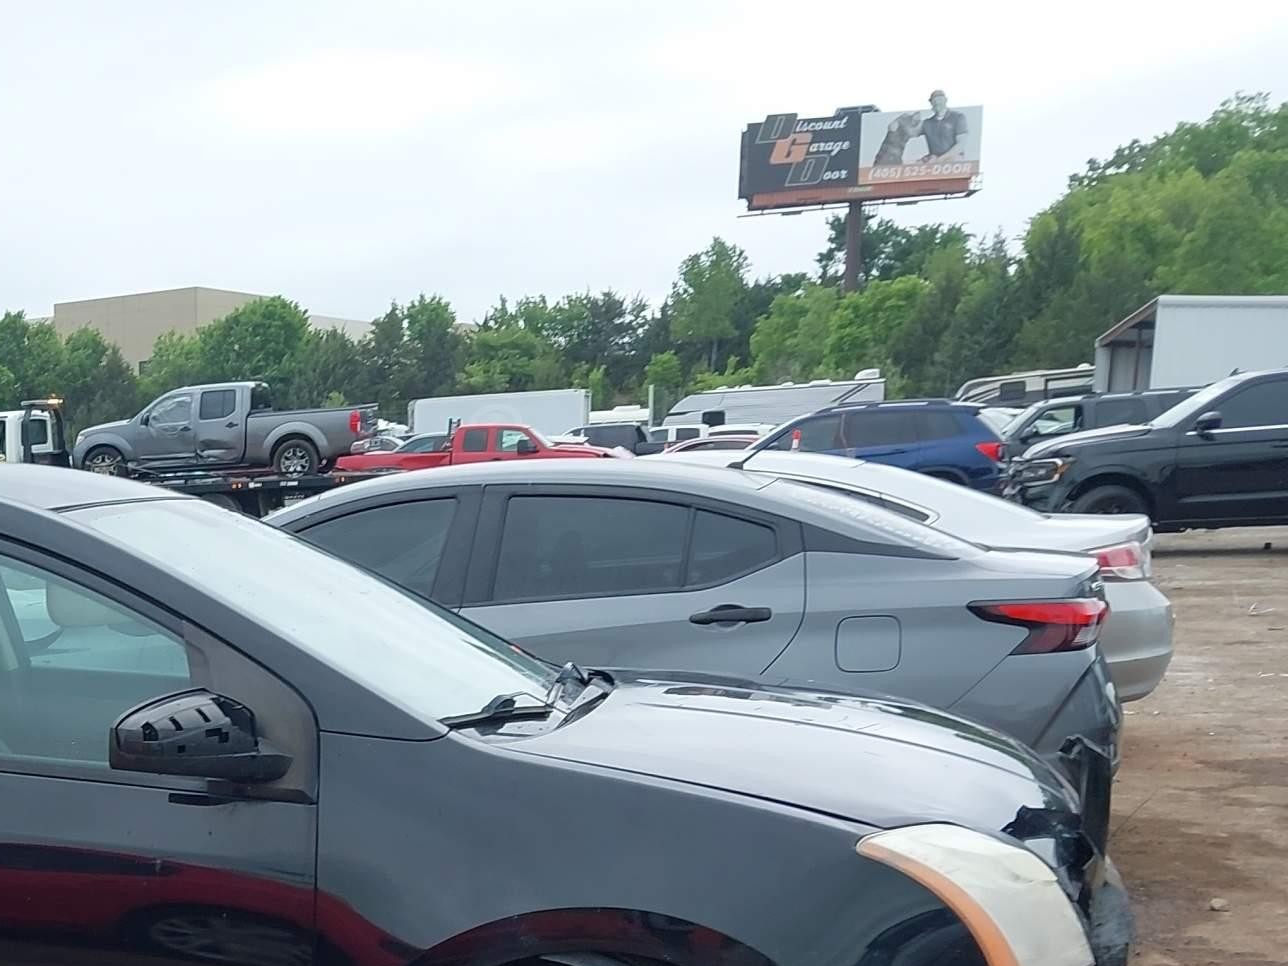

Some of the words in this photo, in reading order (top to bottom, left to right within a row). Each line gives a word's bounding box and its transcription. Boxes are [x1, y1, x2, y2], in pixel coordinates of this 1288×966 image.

[755, 113, 849, 144] Discount
[769, 132, 850, 165] Garage
[784, 153, 849, 187] Door
